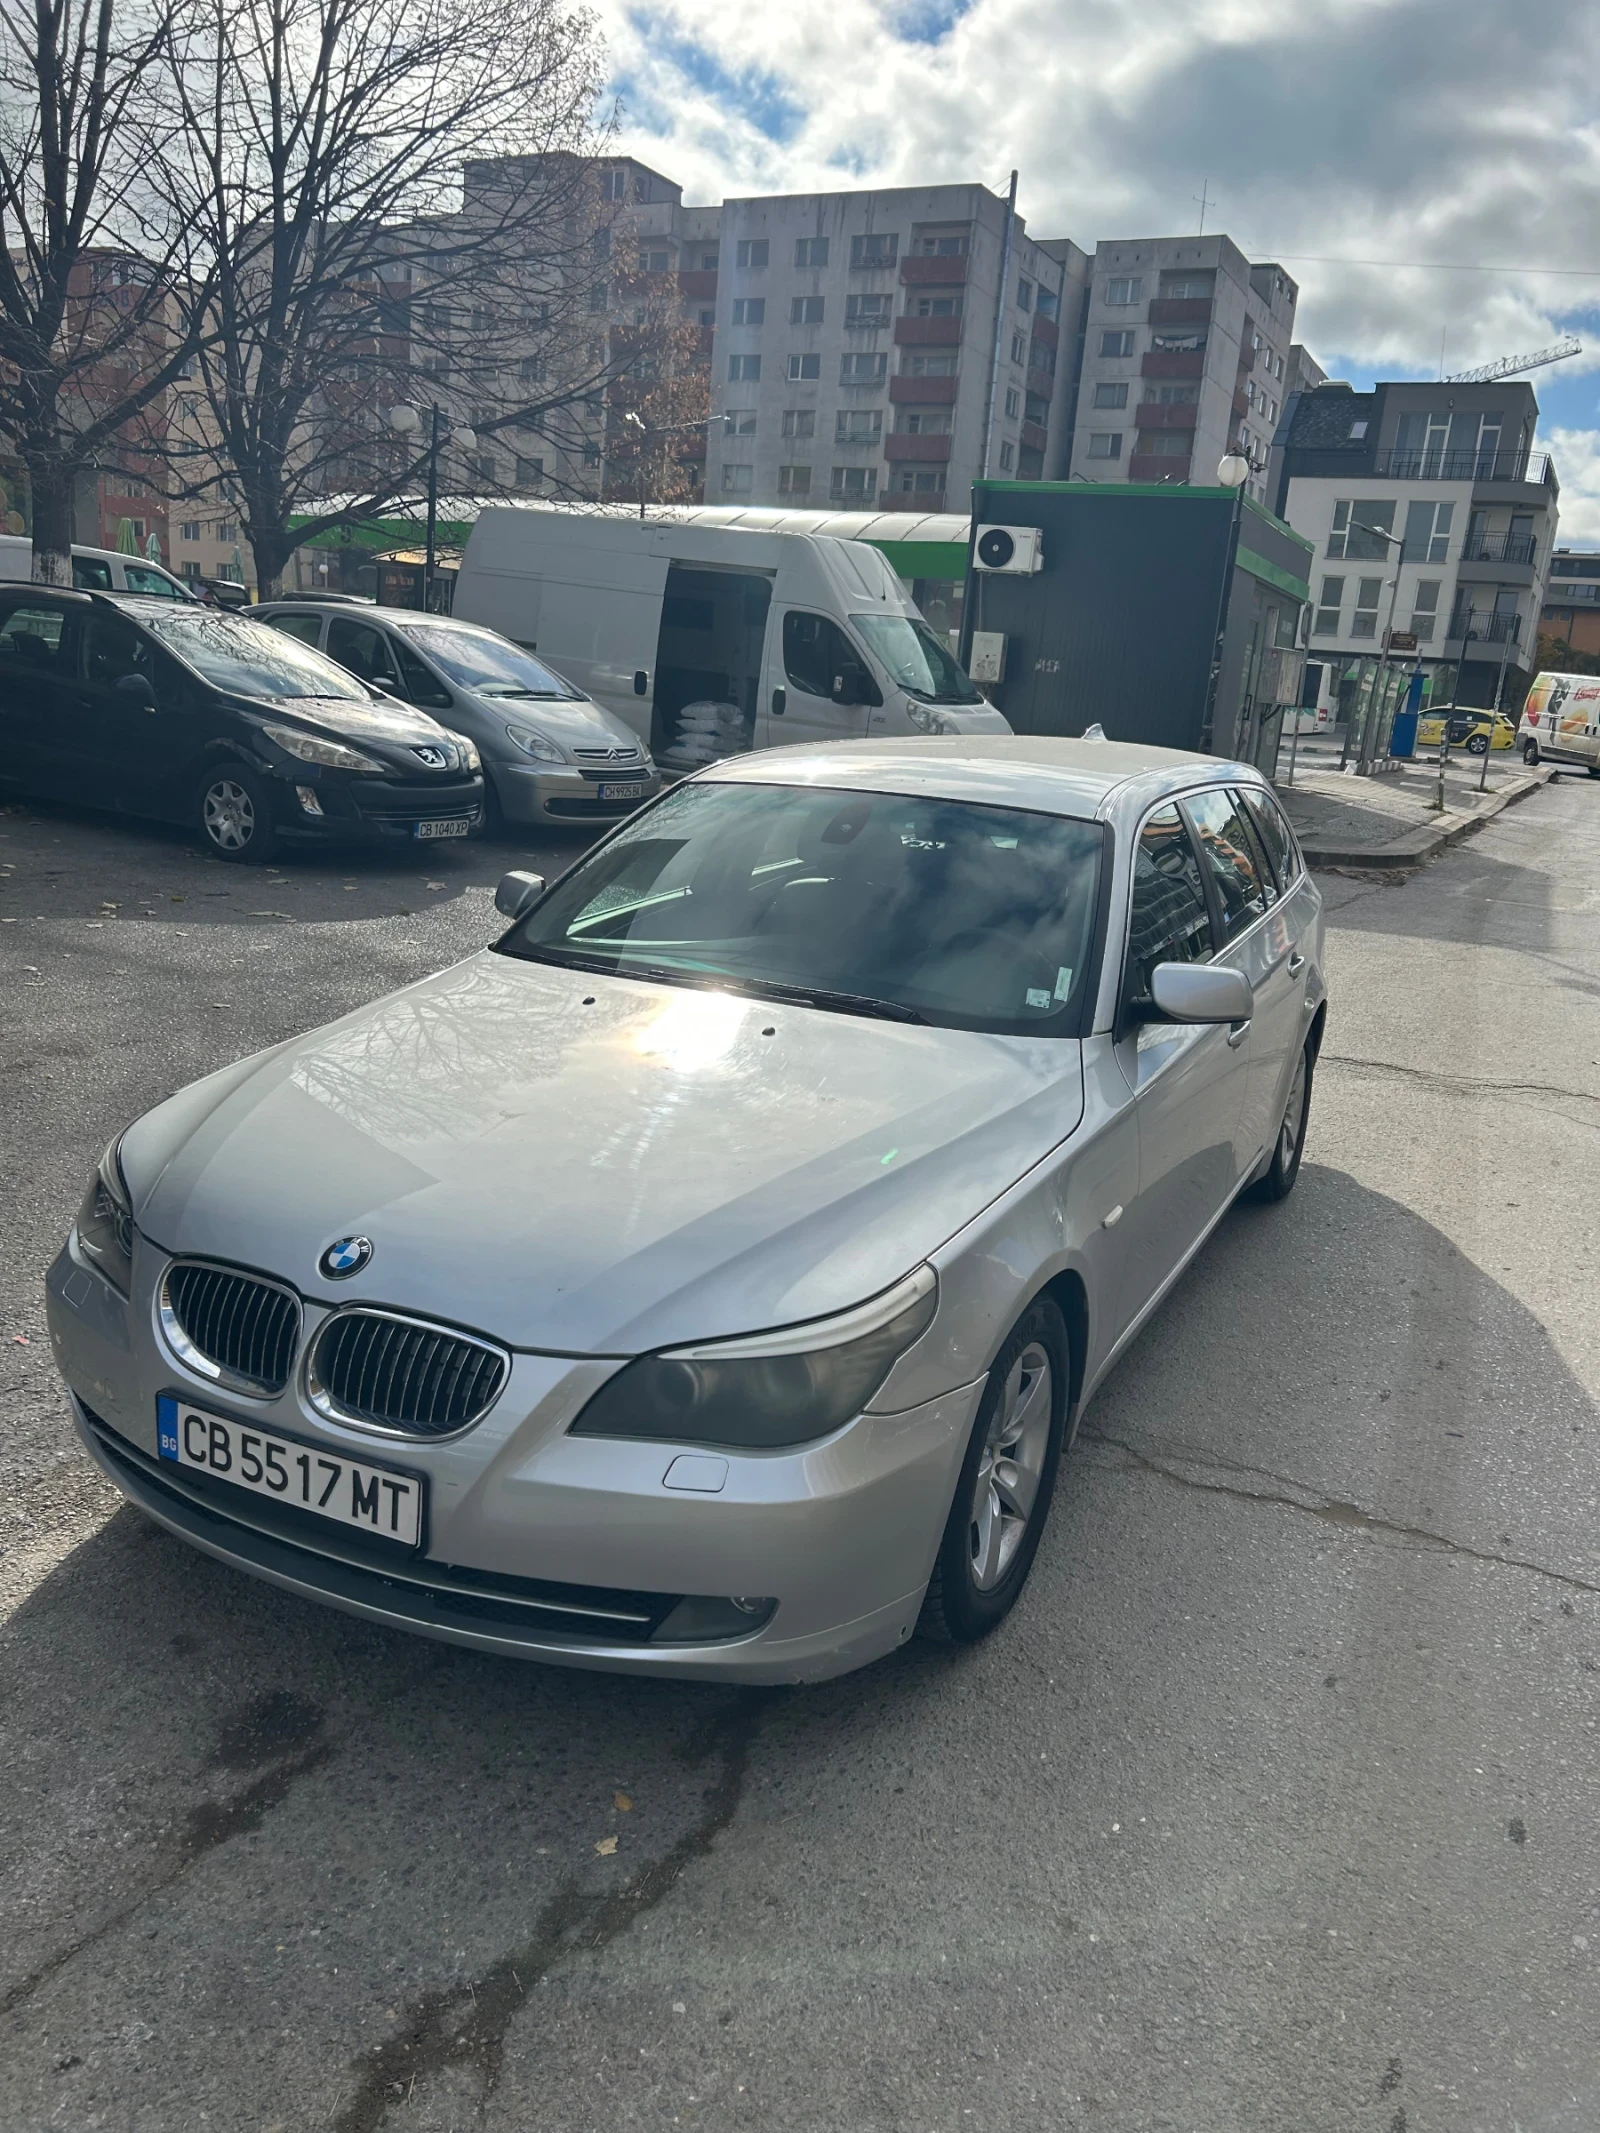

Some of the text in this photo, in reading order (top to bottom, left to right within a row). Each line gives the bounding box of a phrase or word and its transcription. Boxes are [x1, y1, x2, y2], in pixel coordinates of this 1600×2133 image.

[605, 786, 616, 798] CH
[616, 786, 632, 798] 9925
[420, 823, 432, 837] CB
[434, 822, 455, 836] 1040
[455, 821, 468, 835] XP
[161, 1434, 177, 1452] BG
[184, 1414, 410, 1531] CB 5517 MT
